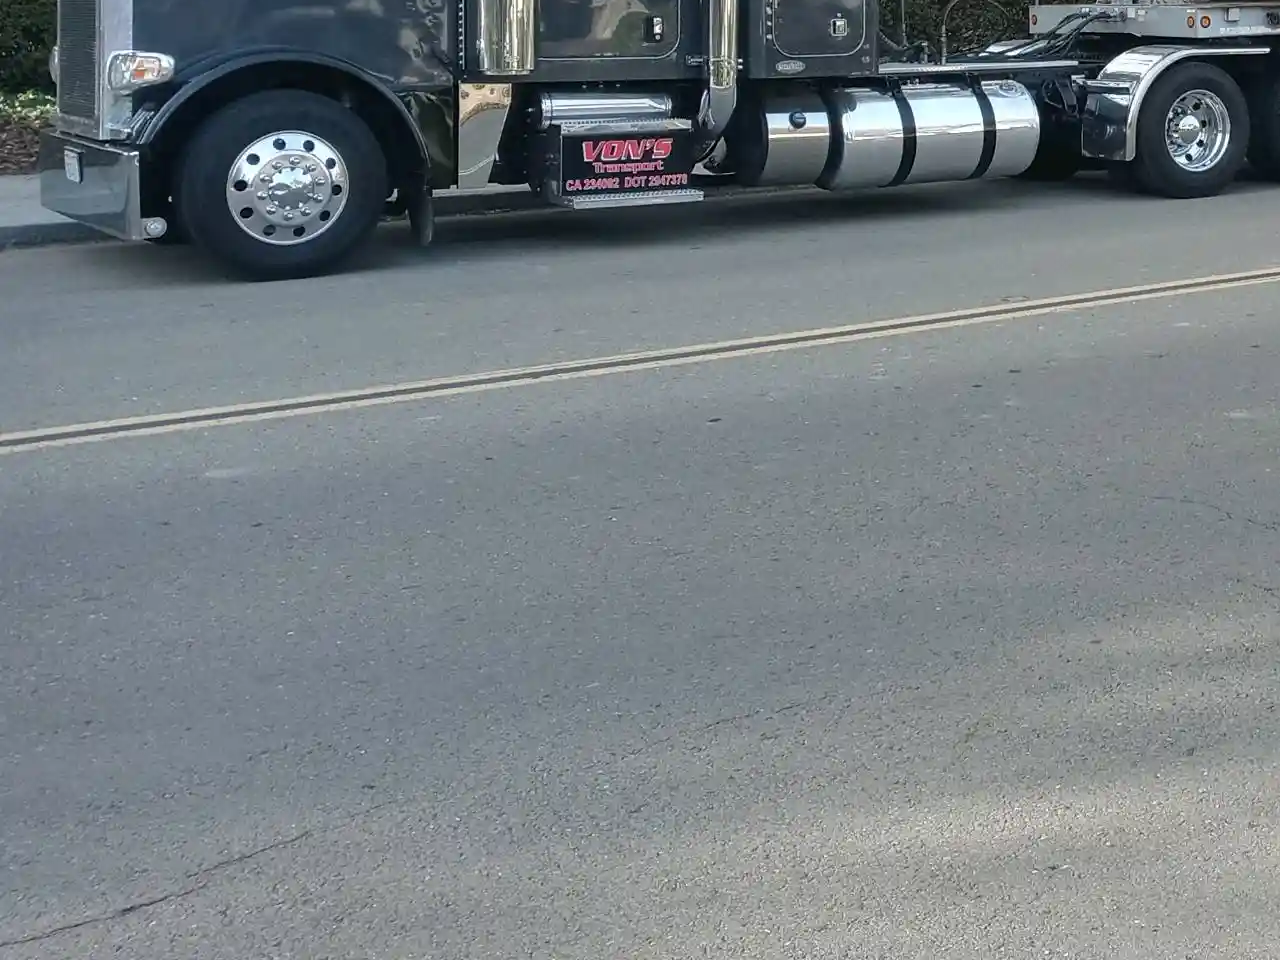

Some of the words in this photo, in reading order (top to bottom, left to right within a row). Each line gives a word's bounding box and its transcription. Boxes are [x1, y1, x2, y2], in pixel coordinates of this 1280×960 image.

[582, 138, 673, 162] VON'S
[592, 160, 664, 174] Transport
[565, 179, 582, 191] CA
[624, 175, 647, 188] DOT
